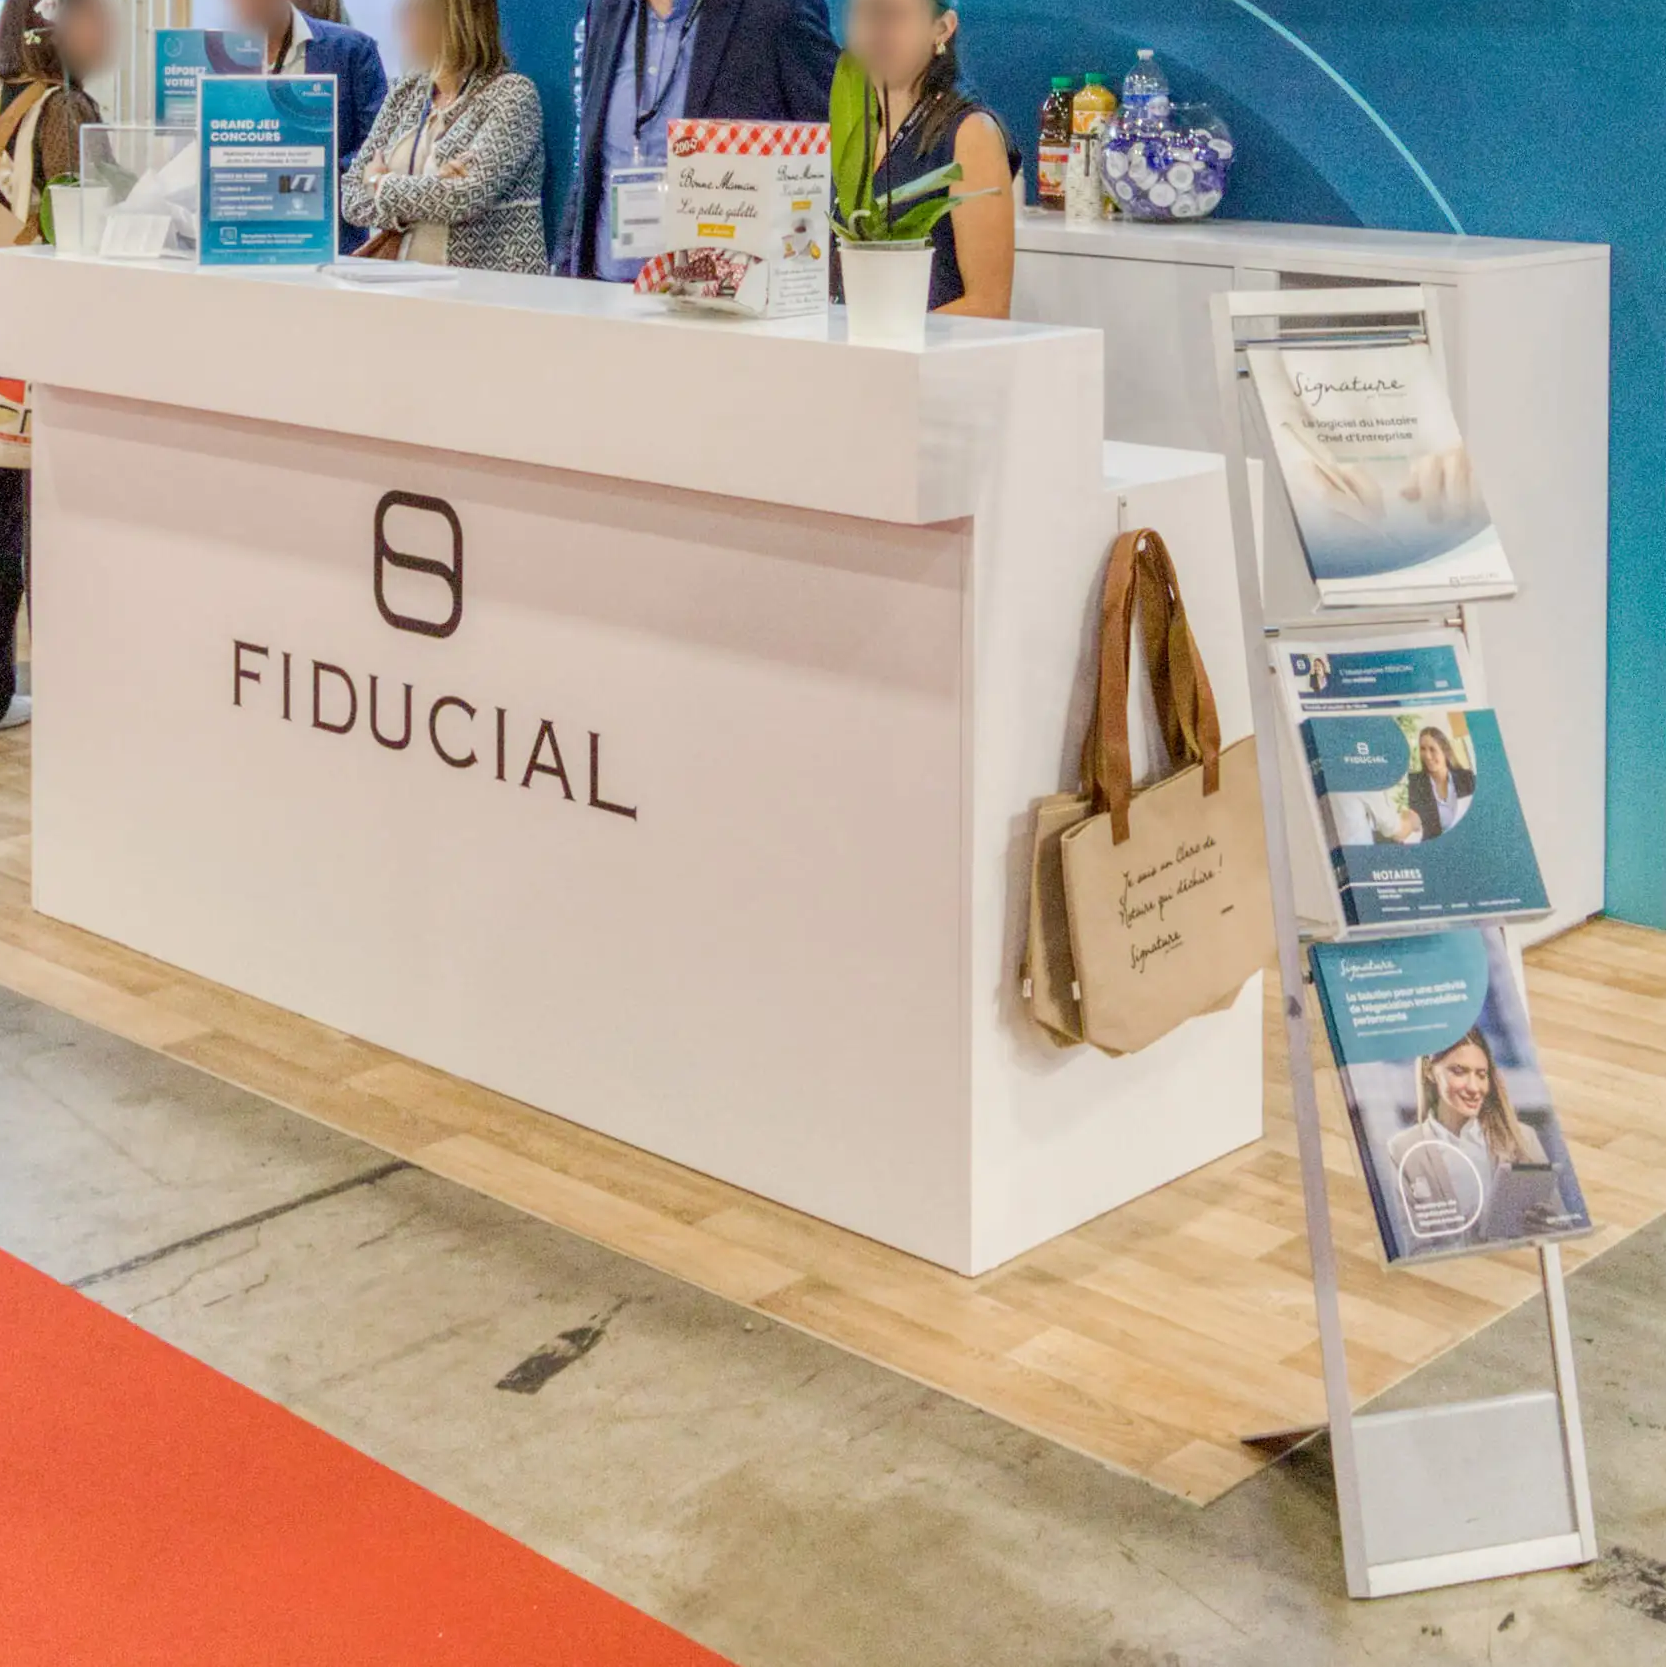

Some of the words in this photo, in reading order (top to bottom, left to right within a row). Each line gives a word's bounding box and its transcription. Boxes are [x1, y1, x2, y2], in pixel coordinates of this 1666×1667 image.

[210, 119, 255, 130] GRAND
[257, 119, 280, 130] JEU
[210, 131, 282, 142] CONCOURS
[679, 167, 715, 191] Bonne
[716, 170, 758, 192] Maman
[676, 198, 696, 215] La
[695, 201, 723, 220] petite
[726, 200, 759, 223] galette
[1293, 371, 1406, 407] Signature
[1317, 415, 1358, 432] logiciel
[1358, 415, 1375, 429] du
[1375, 414, 1418, 428] Notaire
[1317, 432, 1345, 444] Chef
[1345, 430, 1413, 445] d'Entreprise
[232, 638, 638, 823] FIDUCIAL
[1372, 868, 1423, 881] NOTAIRES
[1130, 931, 1182, 974] Signature
[1340, 957, 1396, 982] Signature
